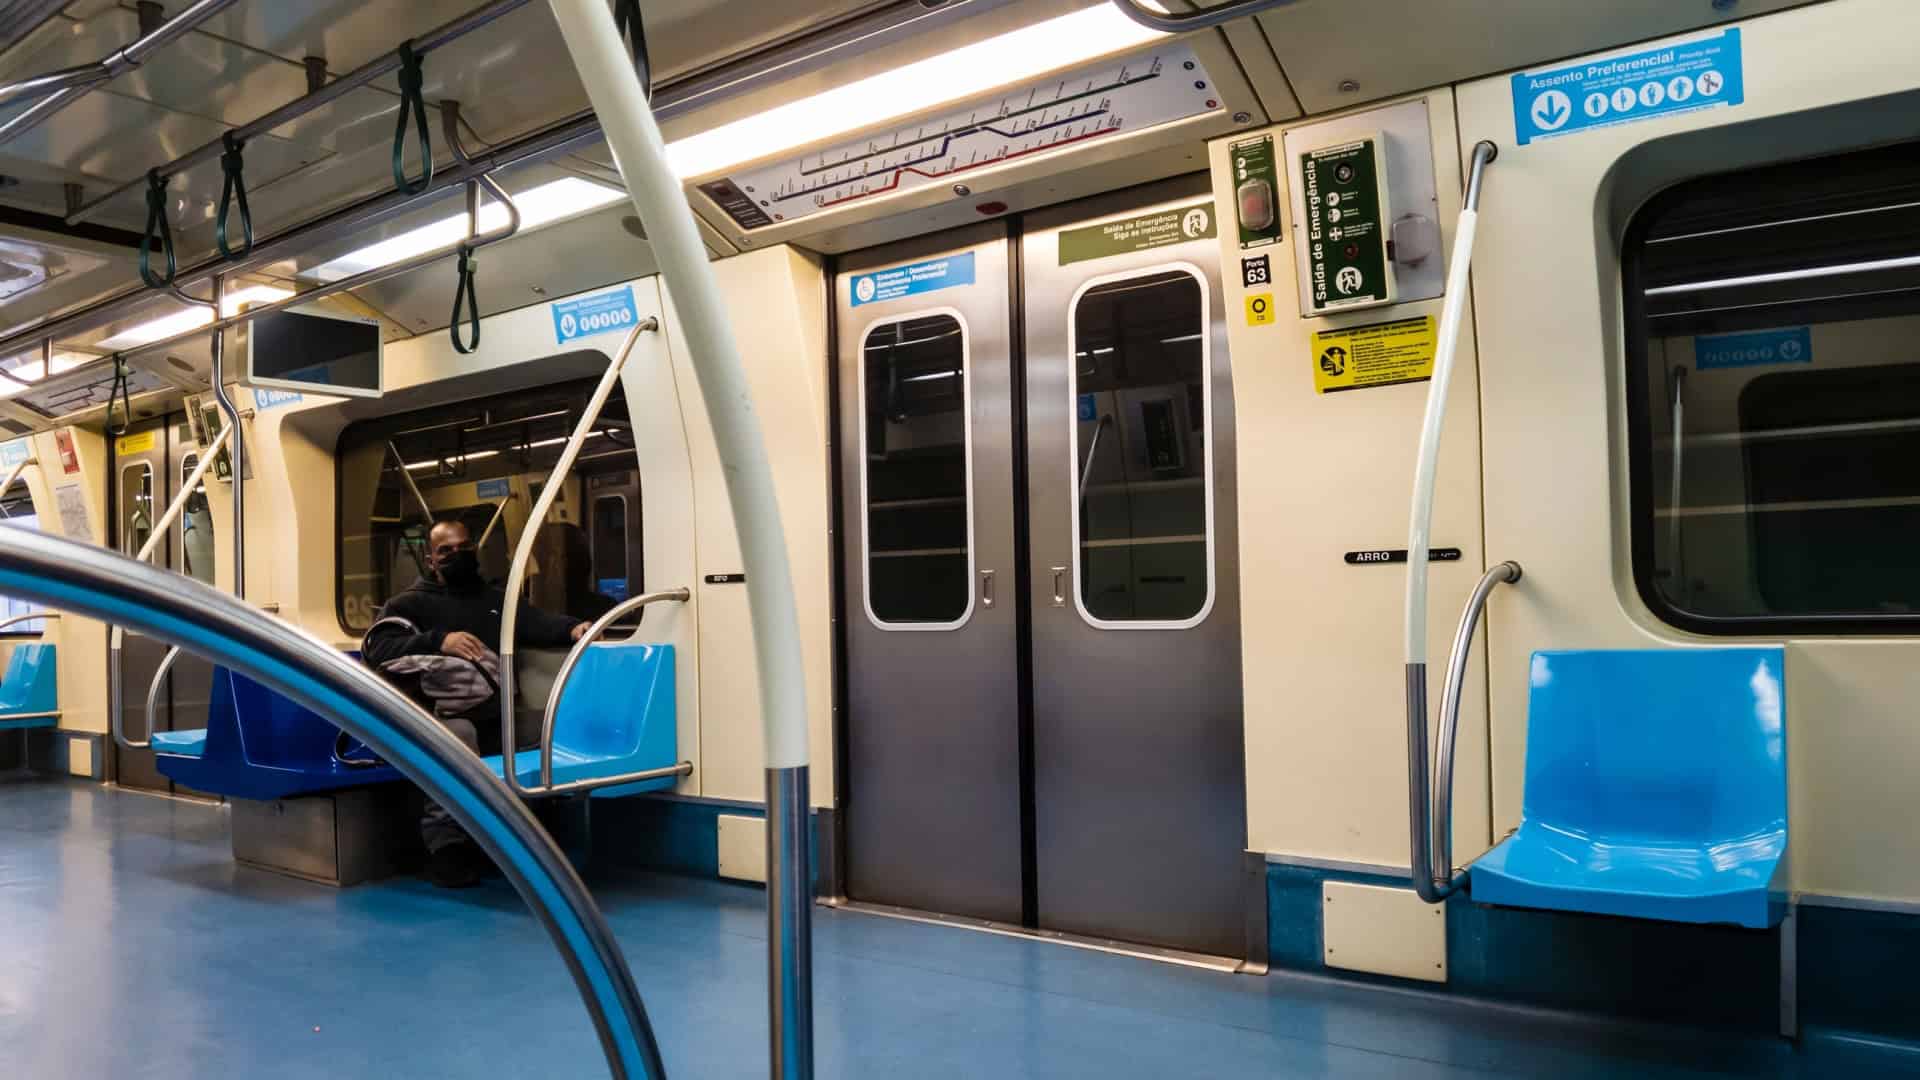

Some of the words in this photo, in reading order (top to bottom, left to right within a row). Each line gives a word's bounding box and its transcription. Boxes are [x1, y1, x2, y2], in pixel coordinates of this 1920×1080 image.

[1530, 72, 1584, 89] Assento
[1587, 51, 1674, 79] Preferencial
[1305, 160, 1322, 241] Emergência
[1312, 243, 1323, 260] de
[1247, 268, 1266, 283] 63
[1314, 262, 1327, 301] Saída
[1356, 551, 1390, 561] ARRO
